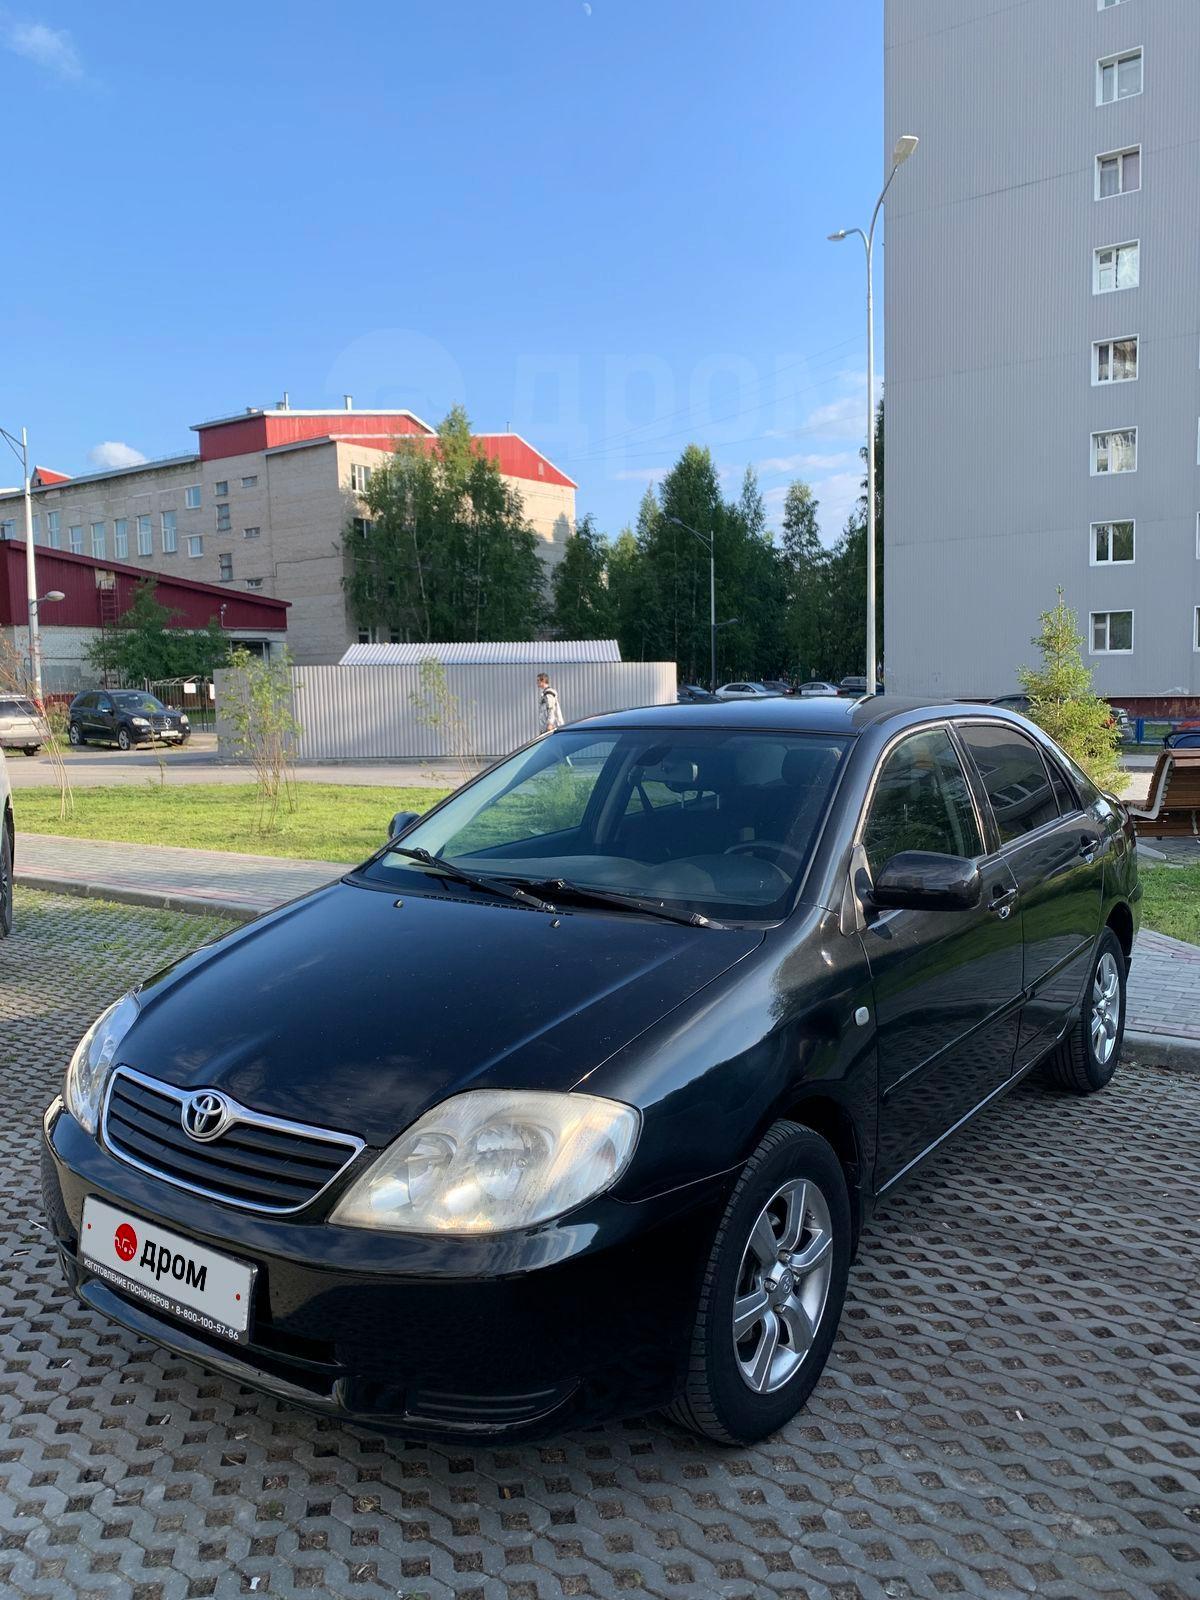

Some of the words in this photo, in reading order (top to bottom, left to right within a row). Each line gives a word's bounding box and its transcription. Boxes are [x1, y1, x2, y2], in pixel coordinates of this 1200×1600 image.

[84, 1258, 127, 1288] ИЗГОТОВЛЕНИЕ
[126, 1281, 170, 1309] ГОСНОМЕРОВ
[175, 1306, 239, 1341] 8-800-100-57-86
